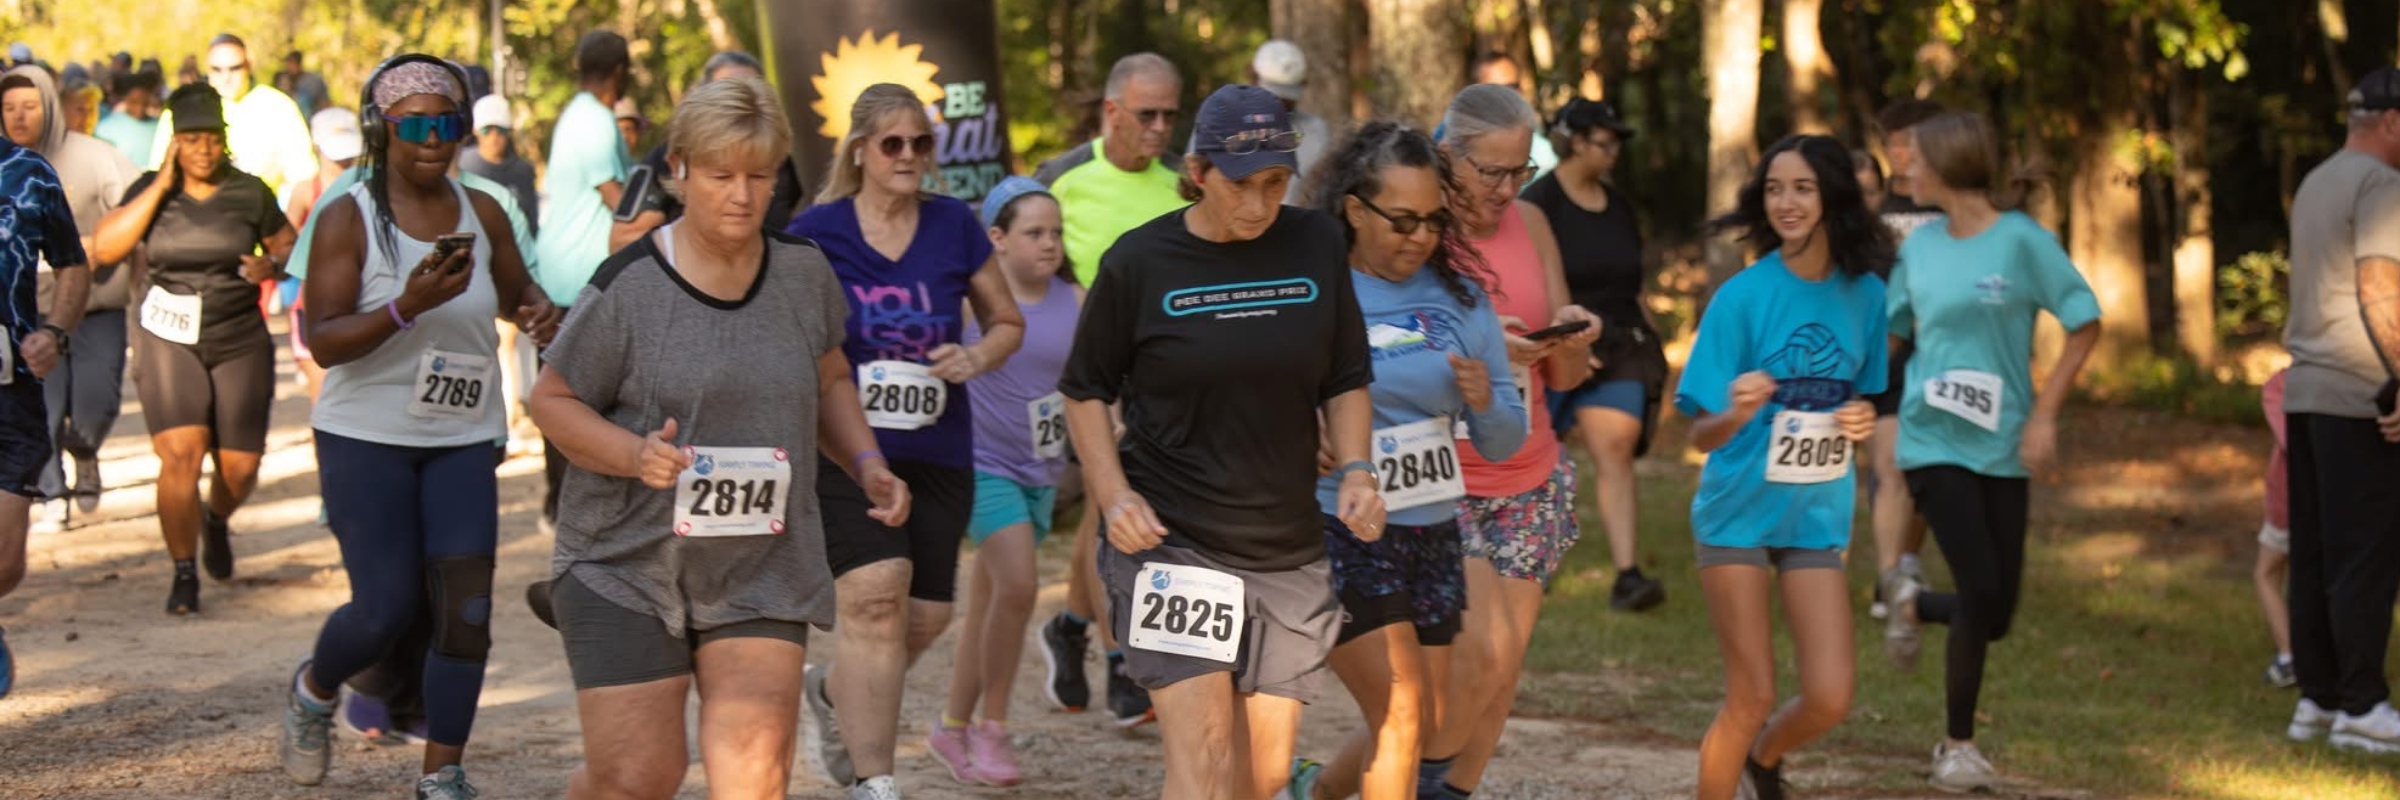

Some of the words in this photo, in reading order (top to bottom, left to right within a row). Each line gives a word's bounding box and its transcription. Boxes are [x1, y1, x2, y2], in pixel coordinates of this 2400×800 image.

[944, 81, 986, 118] BE
[925, 101, 1002, 165] hat
[1174, 296, 1201, 307] PEE
[1203, 292, 1230, 303] DEE
[1231, 288, 1277, 300] GRAND
[1278, 286, 1308, 296] PRIX
[149, 303, 192, 331] 2776
[420, 373, 483, 409] 2789
[864, 383, 938, 415] 2808
[1935, 380, 1992, 415] 2795
[1037, 414, 1066, 447] 28
[1777, 435, 1847, 467] 2809
[1380, 445, 1455, 493] 2840
[689, 478, 776, 517] 2814
[1140, 591, 1234, 643] 2825
